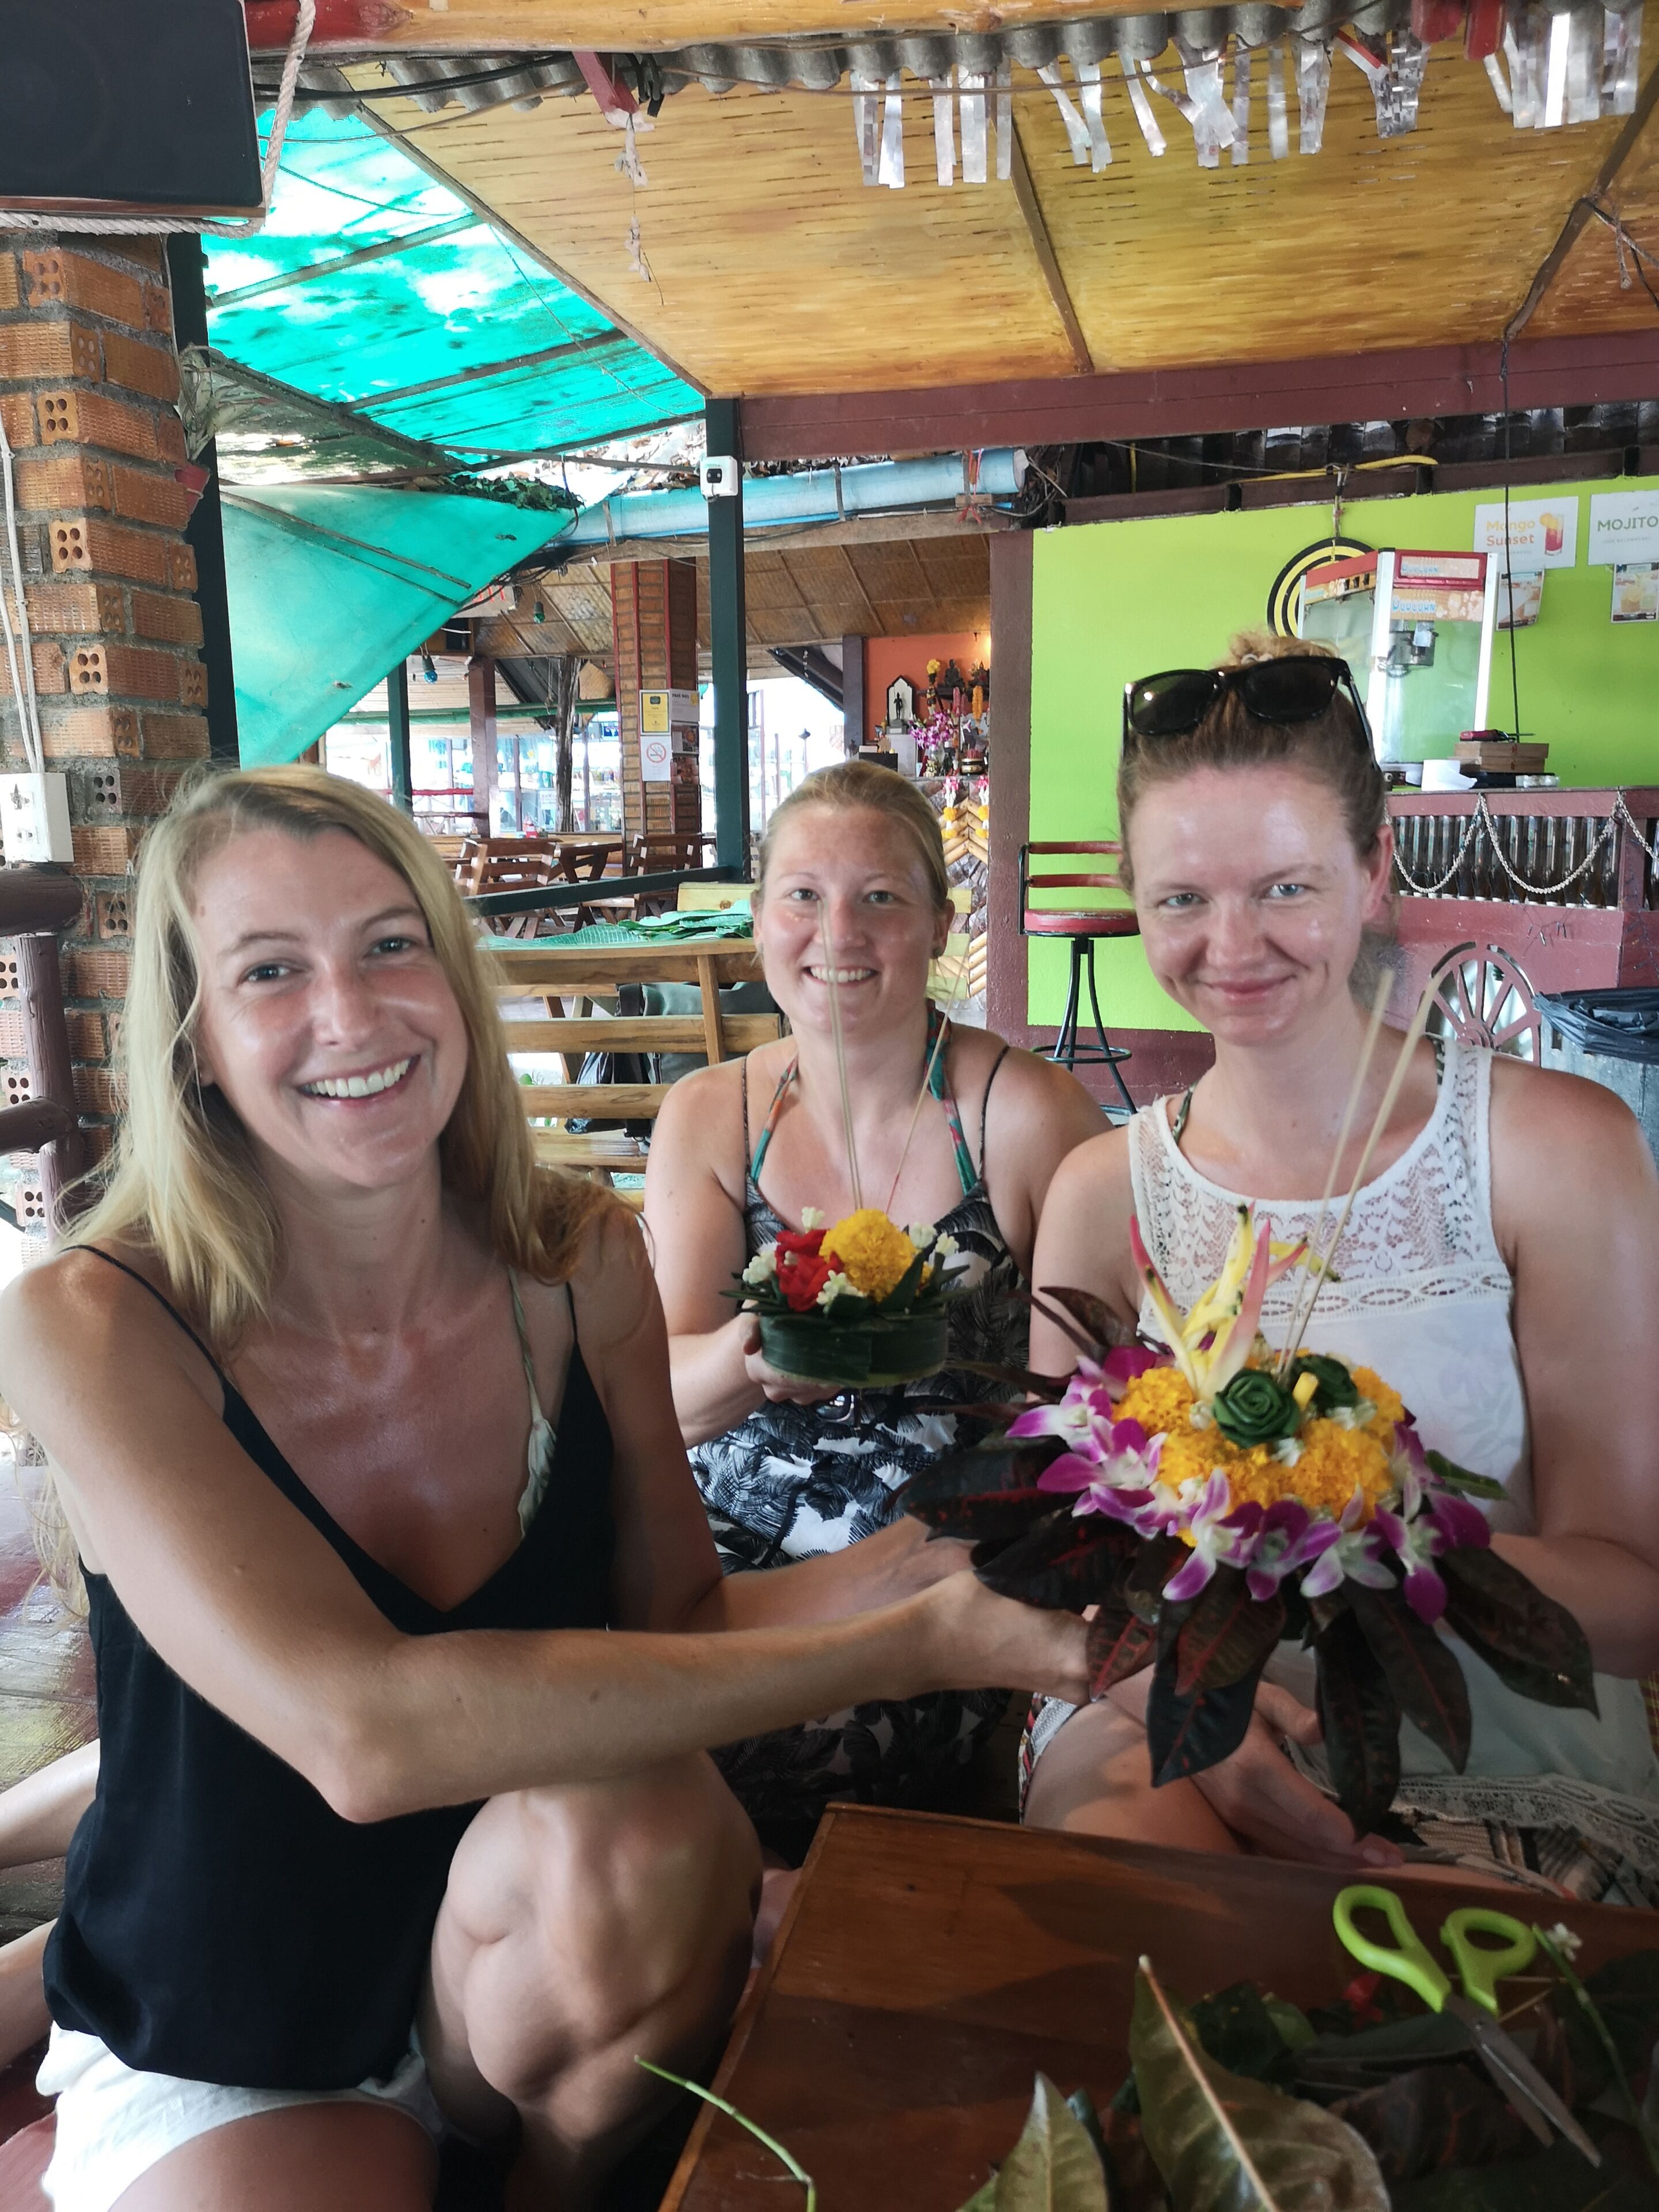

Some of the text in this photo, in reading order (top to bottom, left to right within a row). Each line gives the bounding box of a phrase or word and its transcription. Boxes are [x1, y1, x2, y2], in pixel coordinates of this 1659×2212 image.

[1486, 520, 1535, 532] Mango
[1597, 516, 1658, 531] MOJITO
[1486, 534, 1535, 546] Sunset
